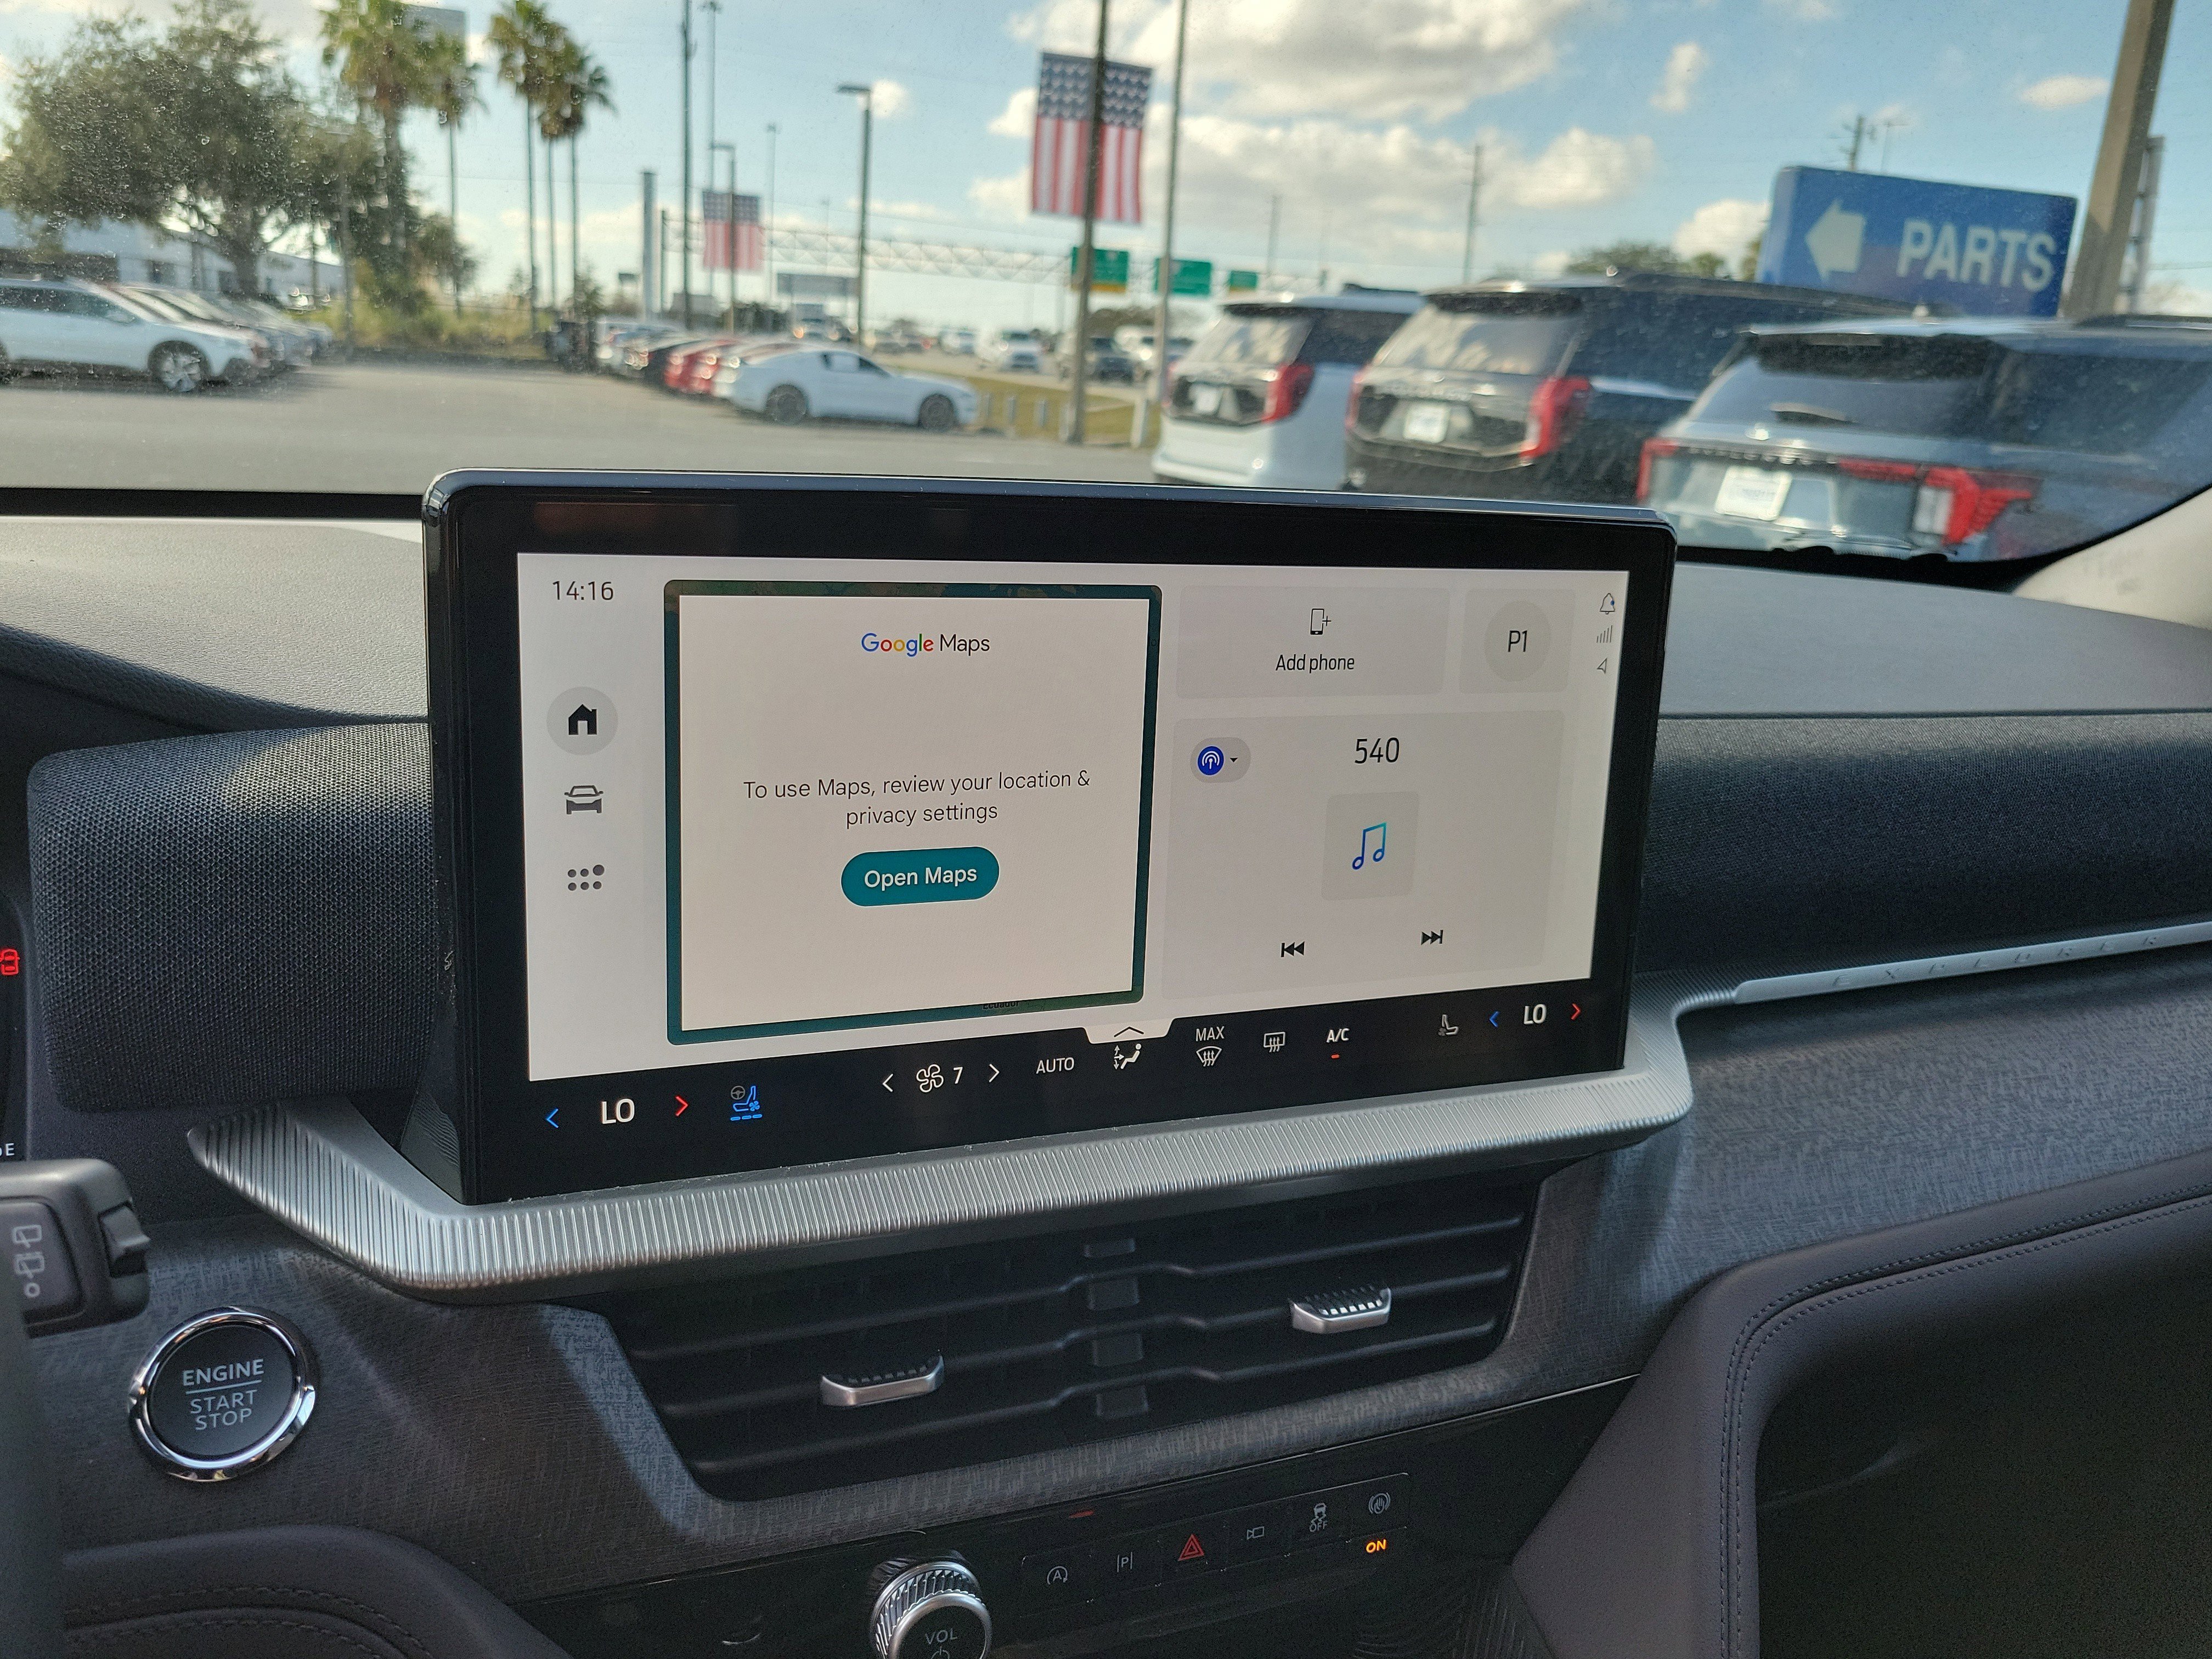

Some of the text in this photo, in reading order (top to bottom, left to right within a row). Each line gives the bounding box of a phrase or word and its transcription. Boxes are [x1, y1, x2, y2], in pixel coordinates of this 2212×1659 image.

[1897, 219, 2056, 292] PARTS
[552, 580, 614, 601] 14:16
[861, 633, 990, 657] Google Maps
[1507, 630, 1528, 652] P1
[1276, 653, 1355, 674] Add phone
[1354, 737, 1400, 764] 540
[743, 769, 1091, 800] To use Maps, review your location &
[846, 802, 998, 830] privacy settings
[864, 866, 978, 891] Open Maps
[1523, 1003, 1547, 1025] LO
[1195, 1026, 1225, 1042] MAX
[1327, 1028, 1350, 1043] A/C
[953, 1066, 963, 1085] 7
[1036, 1056, 1075, 1075] AUTO
[601, 1098, 635, 1125] LO
[0, 1143, 15, 1156] E
[183, 1359, 264, 1386] ENGINE
[190, 1389, 257, 1414] START
[195, 1408, 252, 1431] STOP
[1365, 1539, 1387, 1553] ON
[924, 1627, 958, 1645] VOL
